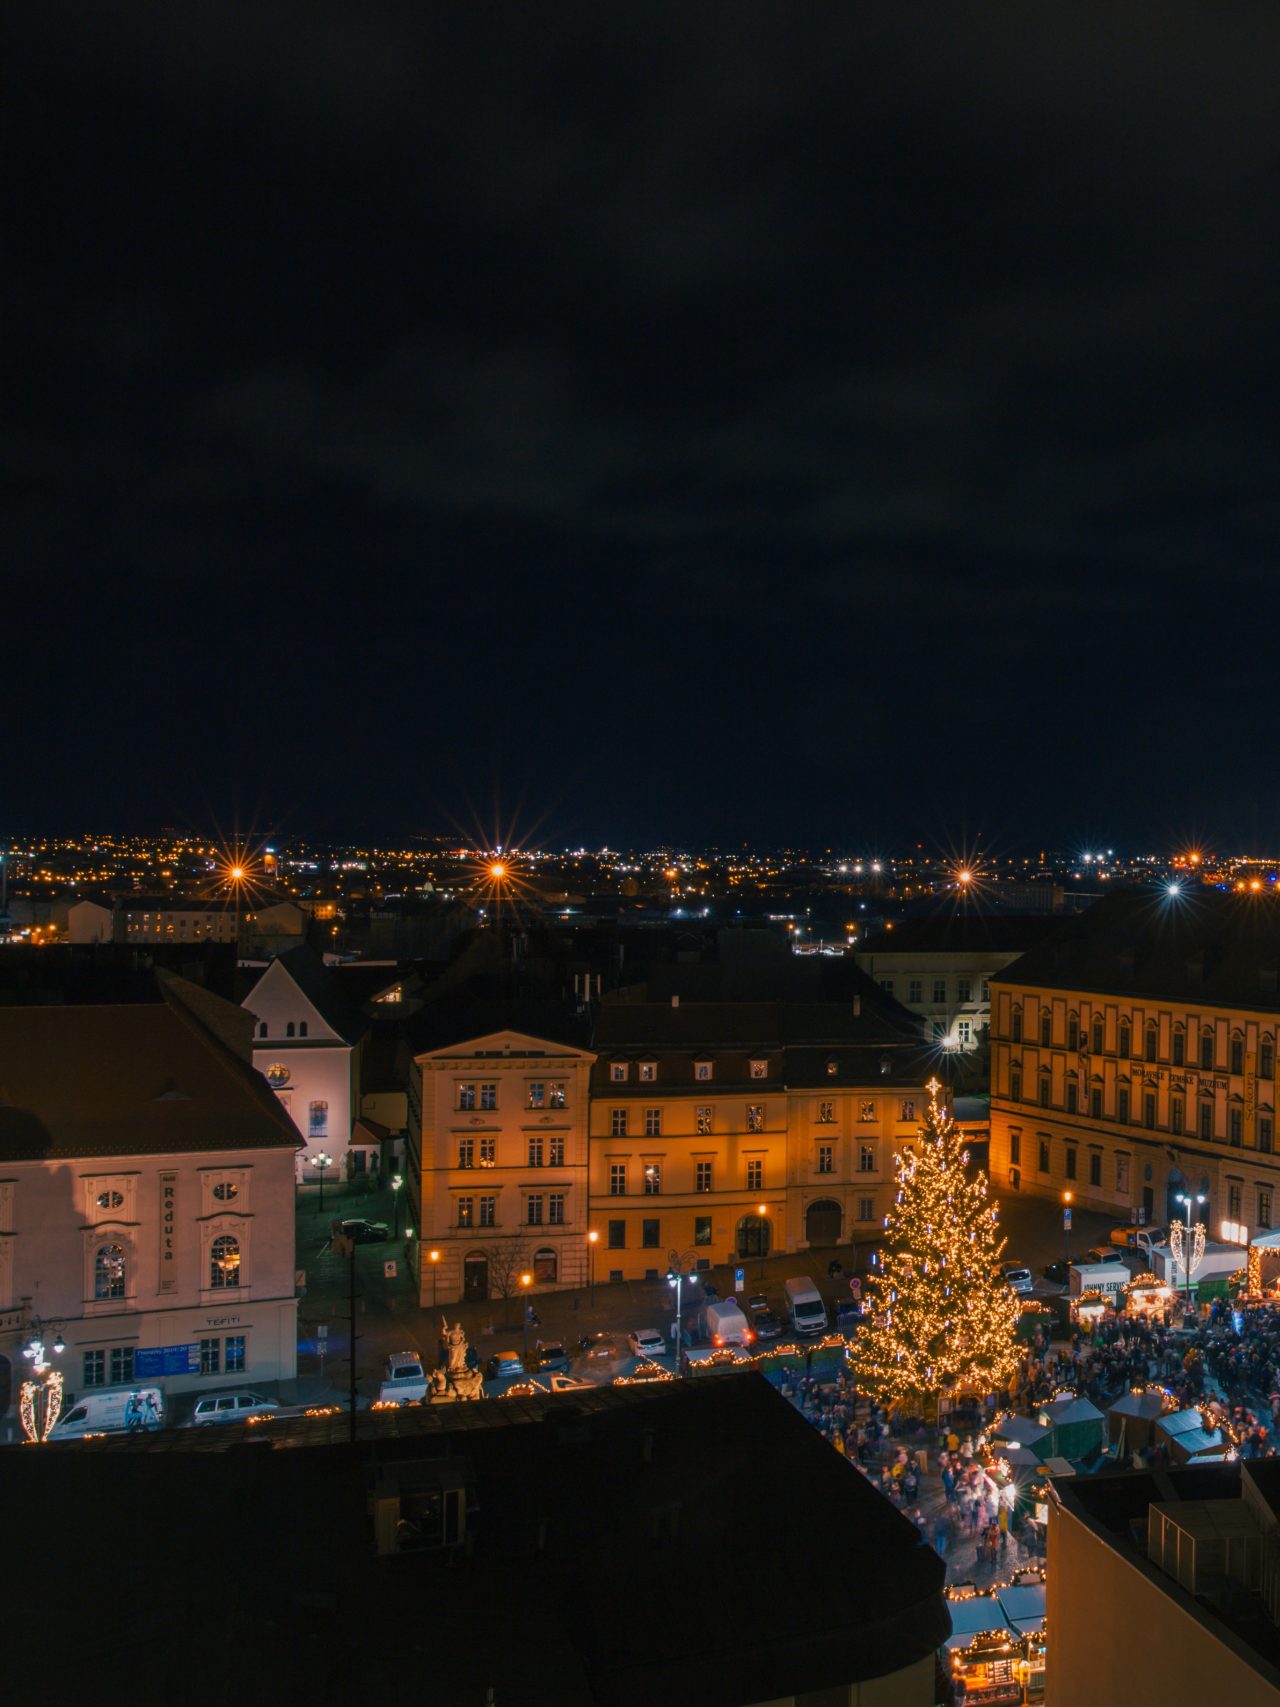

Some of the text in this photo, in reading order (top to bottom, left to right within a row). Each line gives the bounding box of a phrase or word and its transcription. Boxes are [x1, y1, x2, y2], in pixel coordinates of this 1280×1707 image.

[1245, 1072, 1254, 1120] Sekora
[164, 1187, 174, 1260] Reduta
[1084, 1281, 1125, 1292] JOHNNY SERVIS
